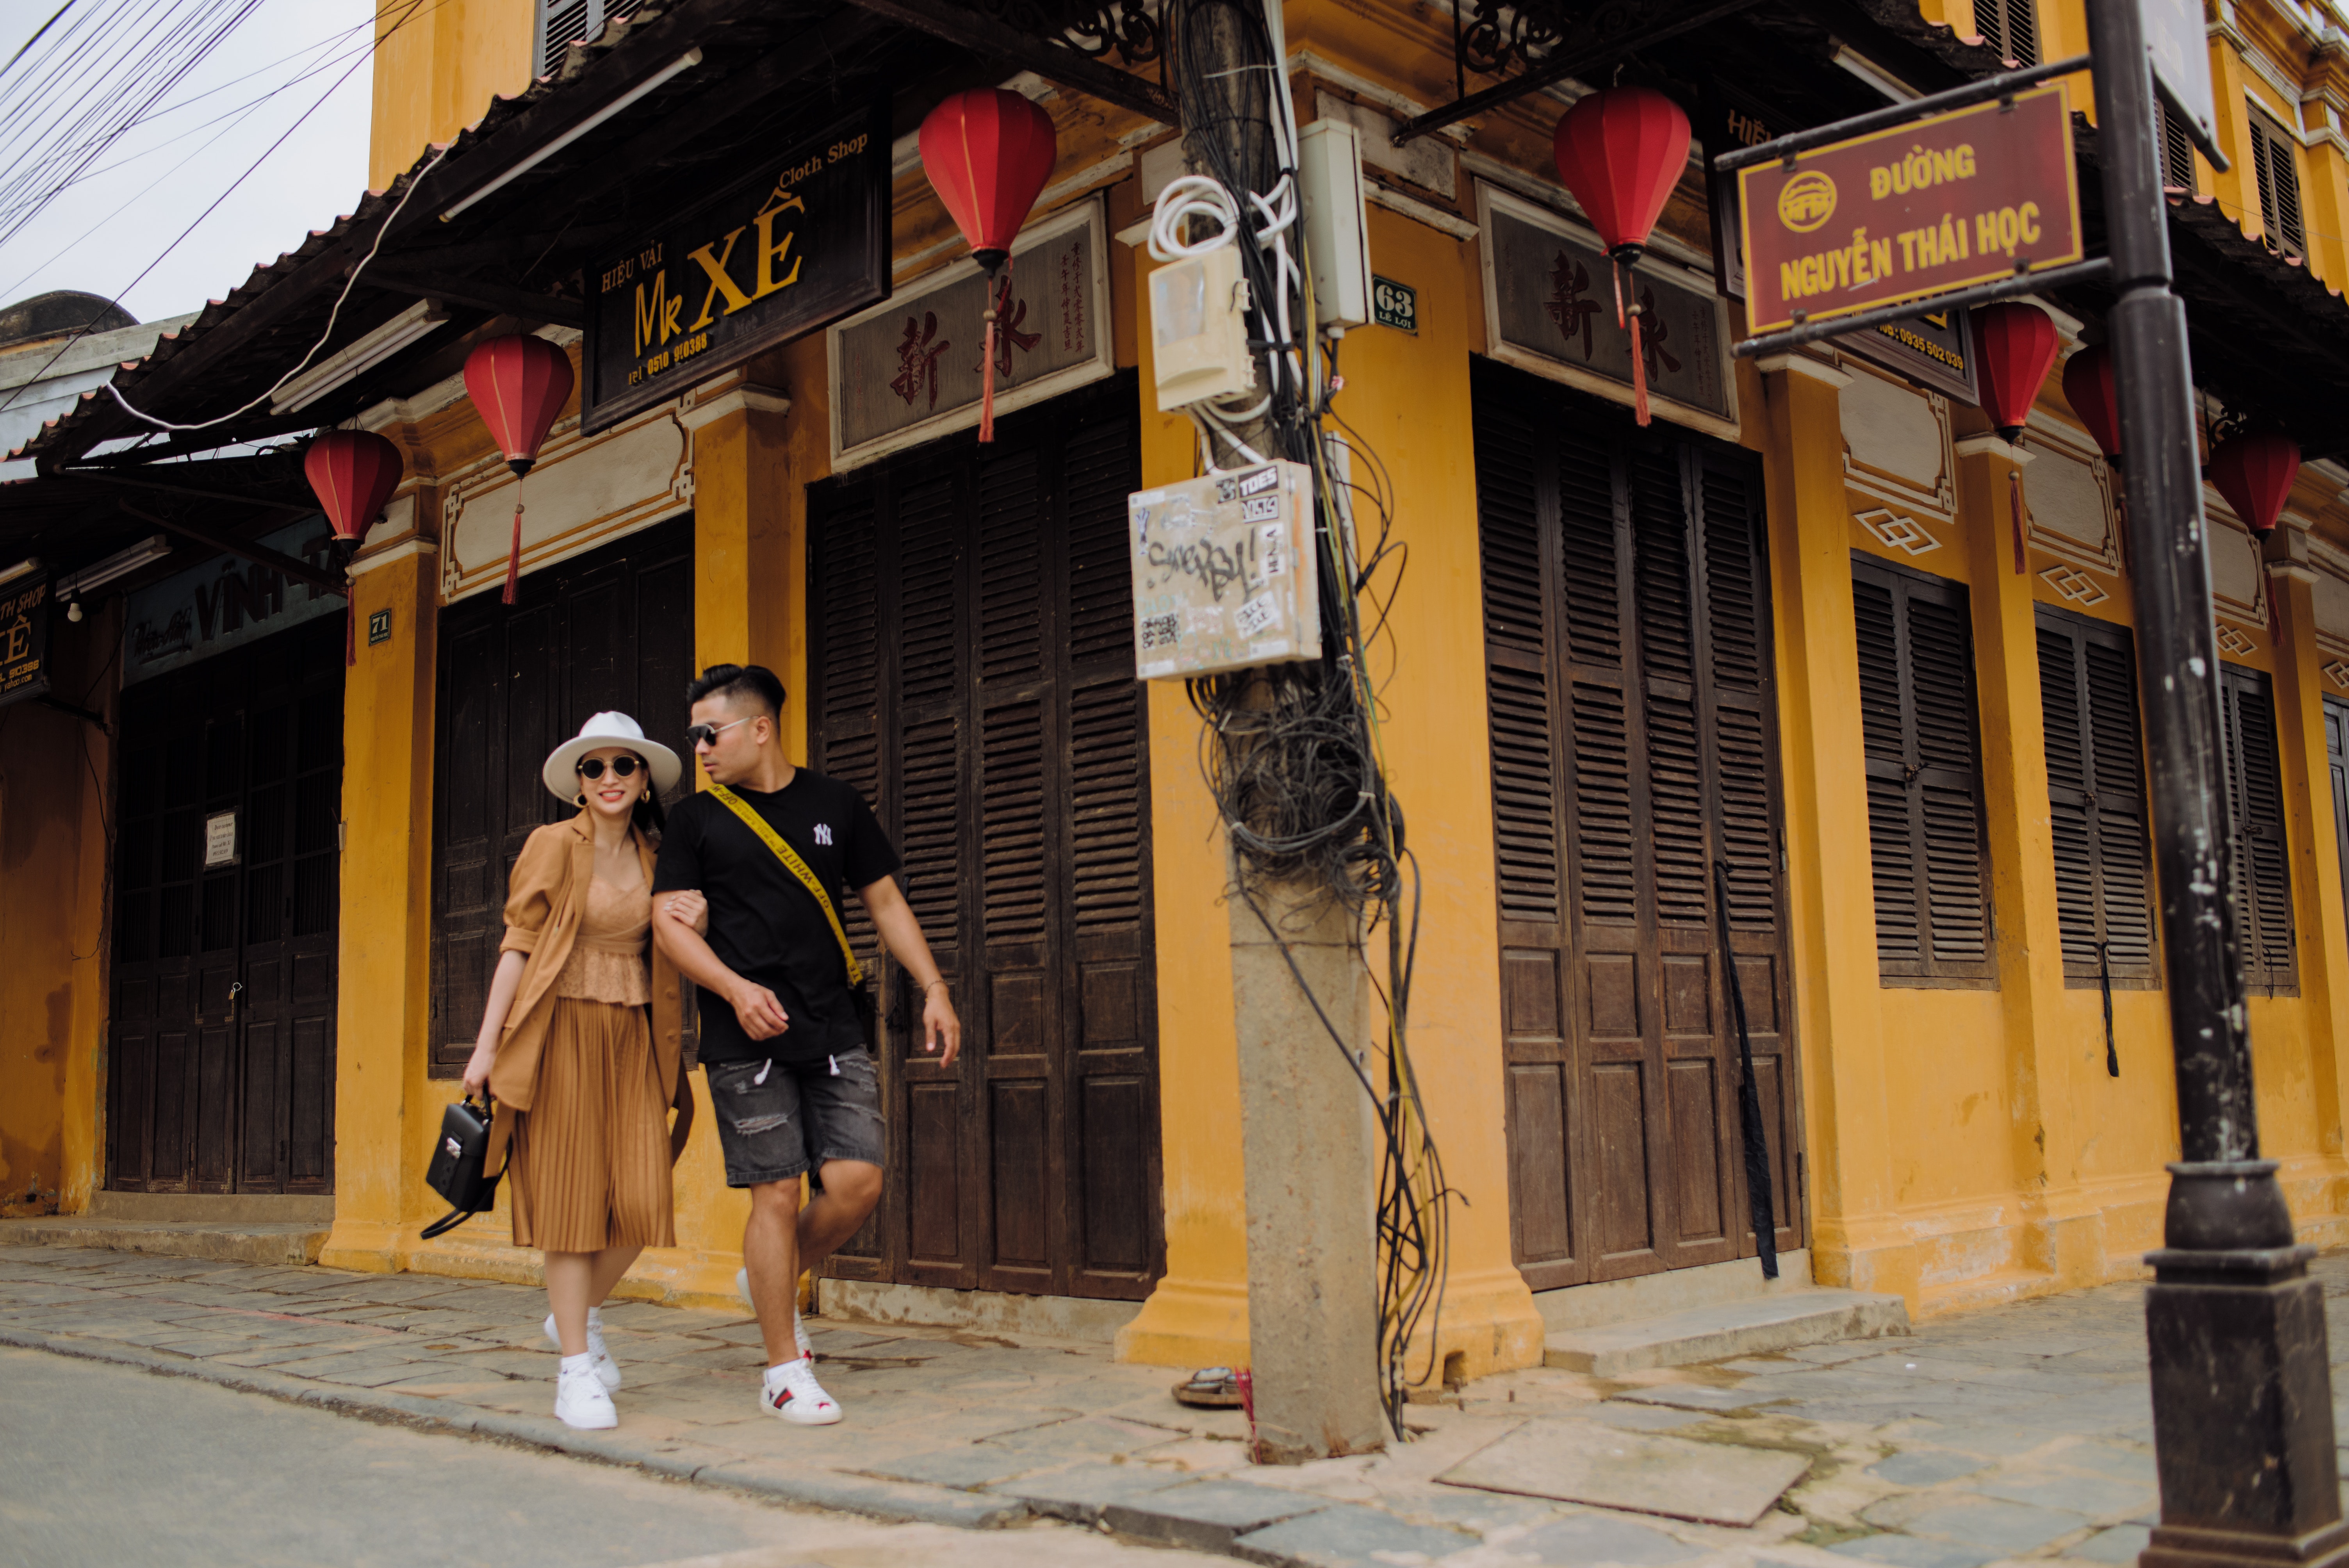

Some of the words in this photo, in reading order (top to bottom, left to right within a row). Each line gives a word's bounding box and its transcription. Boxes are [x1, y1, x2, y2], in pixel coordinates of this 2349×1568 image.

[780, 155, 822, 188] Cloth
[828, 133, 868, 163] Shop
[1870, 144, 1976, 201] ĐƯỜNG
[602, 258, 634, 293] HIỆU
[640, 240, 663, 271] VẢI
[687, 187, 805, 333] XÊ
[1780, 226, 1893, 301] NGUYỄN
[1897, 213, 1969, 272] THÁI
[1976, 201, 2041, 257] HỌC
[1376, 284, 1413, 317] 63
[1379, 311, 1392, 321] LÊ
[1395, 317, 1412, 328] LỢI
[647, 351, 669, 374] 0510
[1900, 328, 1926, 351] 0935
[1926, 341, 1945, 362] 502
[1945, 350, 1964, 370] 039
[1239, 467, 1277, 496] TOES
[17, 582, 46, 613] SHOP
[372, 614, 388, 634] 71
[4, 674, 32, 692] yahoo.com
[9, 659, 39, 679] 910388
[813, 823, 833, 846] NY
